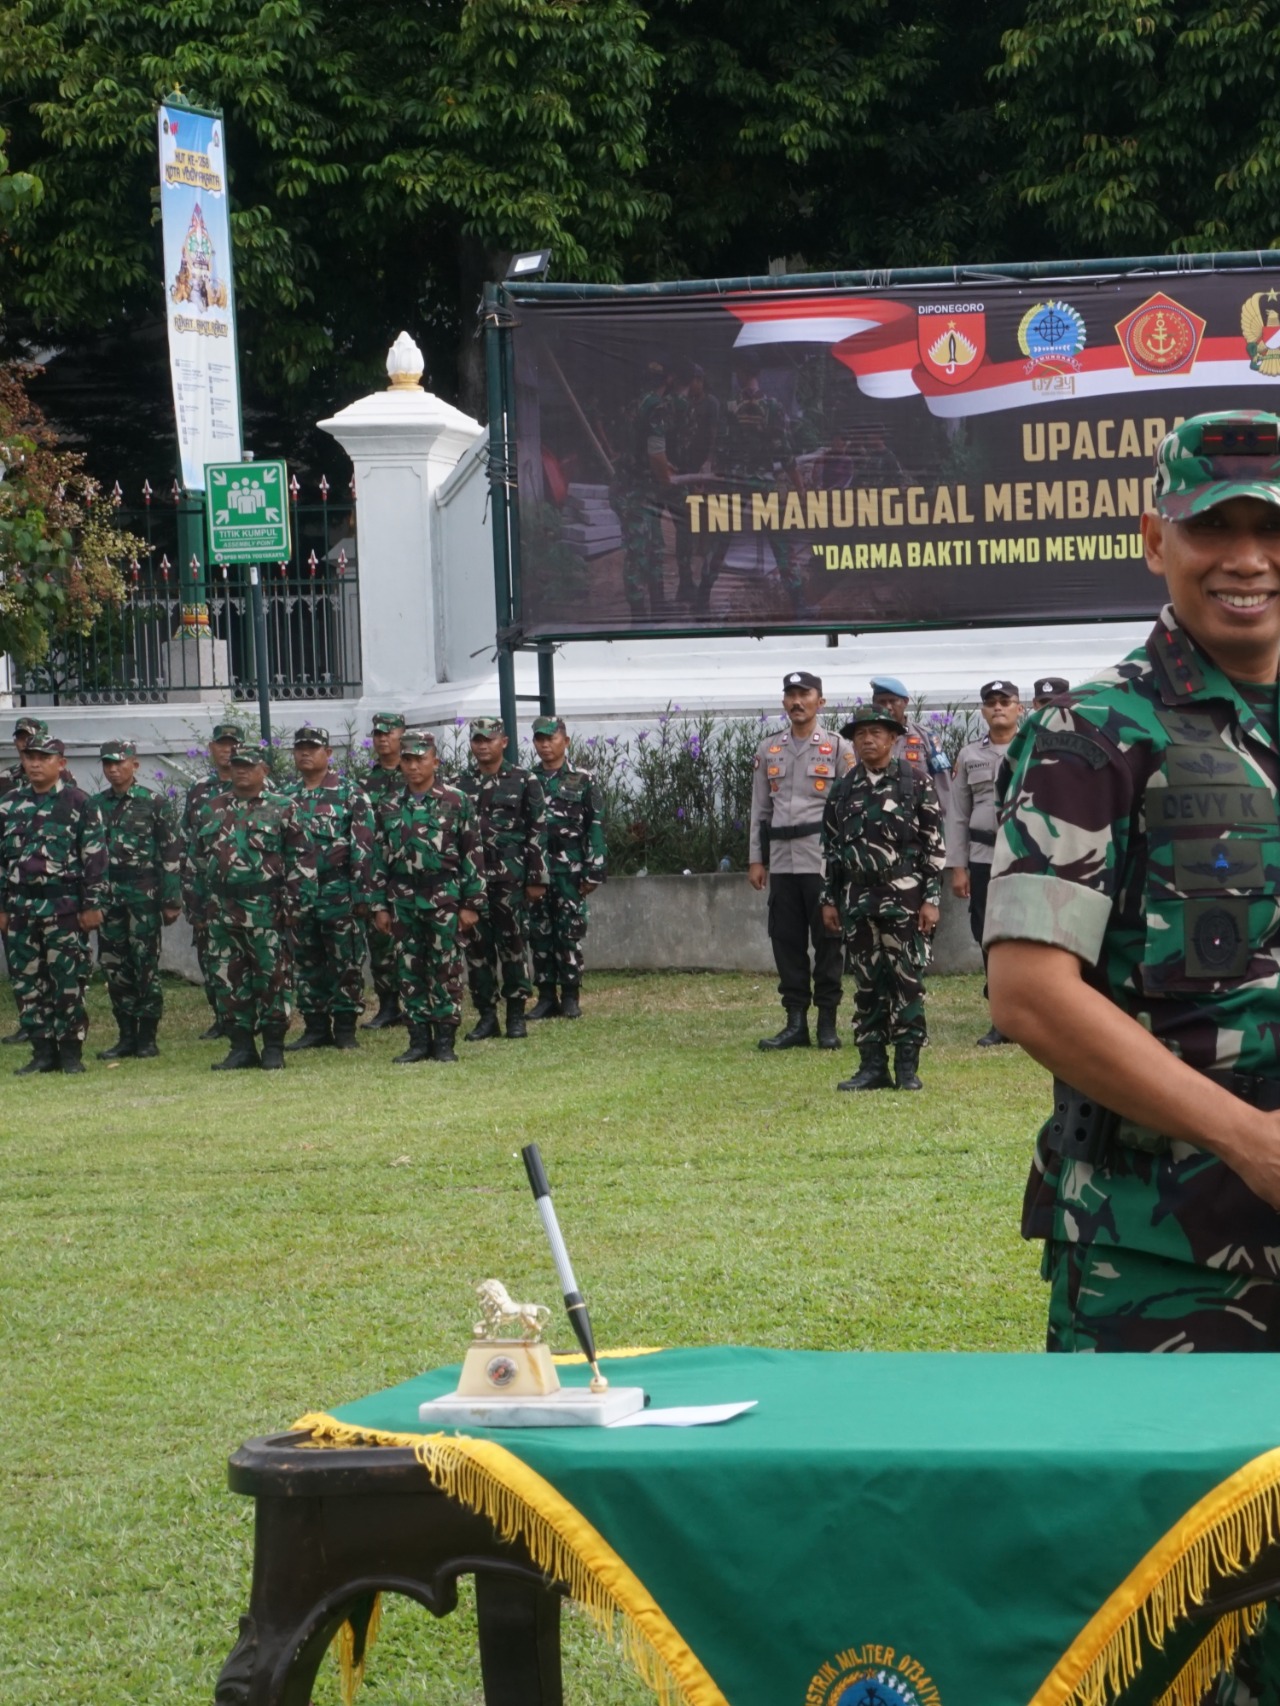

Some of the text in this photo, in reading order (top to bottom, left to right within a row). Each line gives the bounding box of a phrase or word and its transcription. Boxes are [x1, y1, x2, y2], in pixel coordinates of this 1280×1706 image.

[918, 303, 984, 314] DIPONEGORO
[1022, 416, 1186, 462] UPACAR
[686, 493, 742, 533] TNI
[752, 485, 975, 531] MANUNGGAL
[219, 528, 278, 538] TITIK KUMPUL
[222, 539, 275, 548] ASSEMBLY POINT
[907, 540, 972, 568] BAKTI
[977, 537, 1040, 565] TMMD
[1046, 533, 1144, 563] MEWUJU
[811, 756, 835, 764] POLRI
[1163, 793, 1259, 819] DEVY K
[835, 1644, 896, 1671] MILITER
[897, 1654, 942, 1706] 0734/Y
